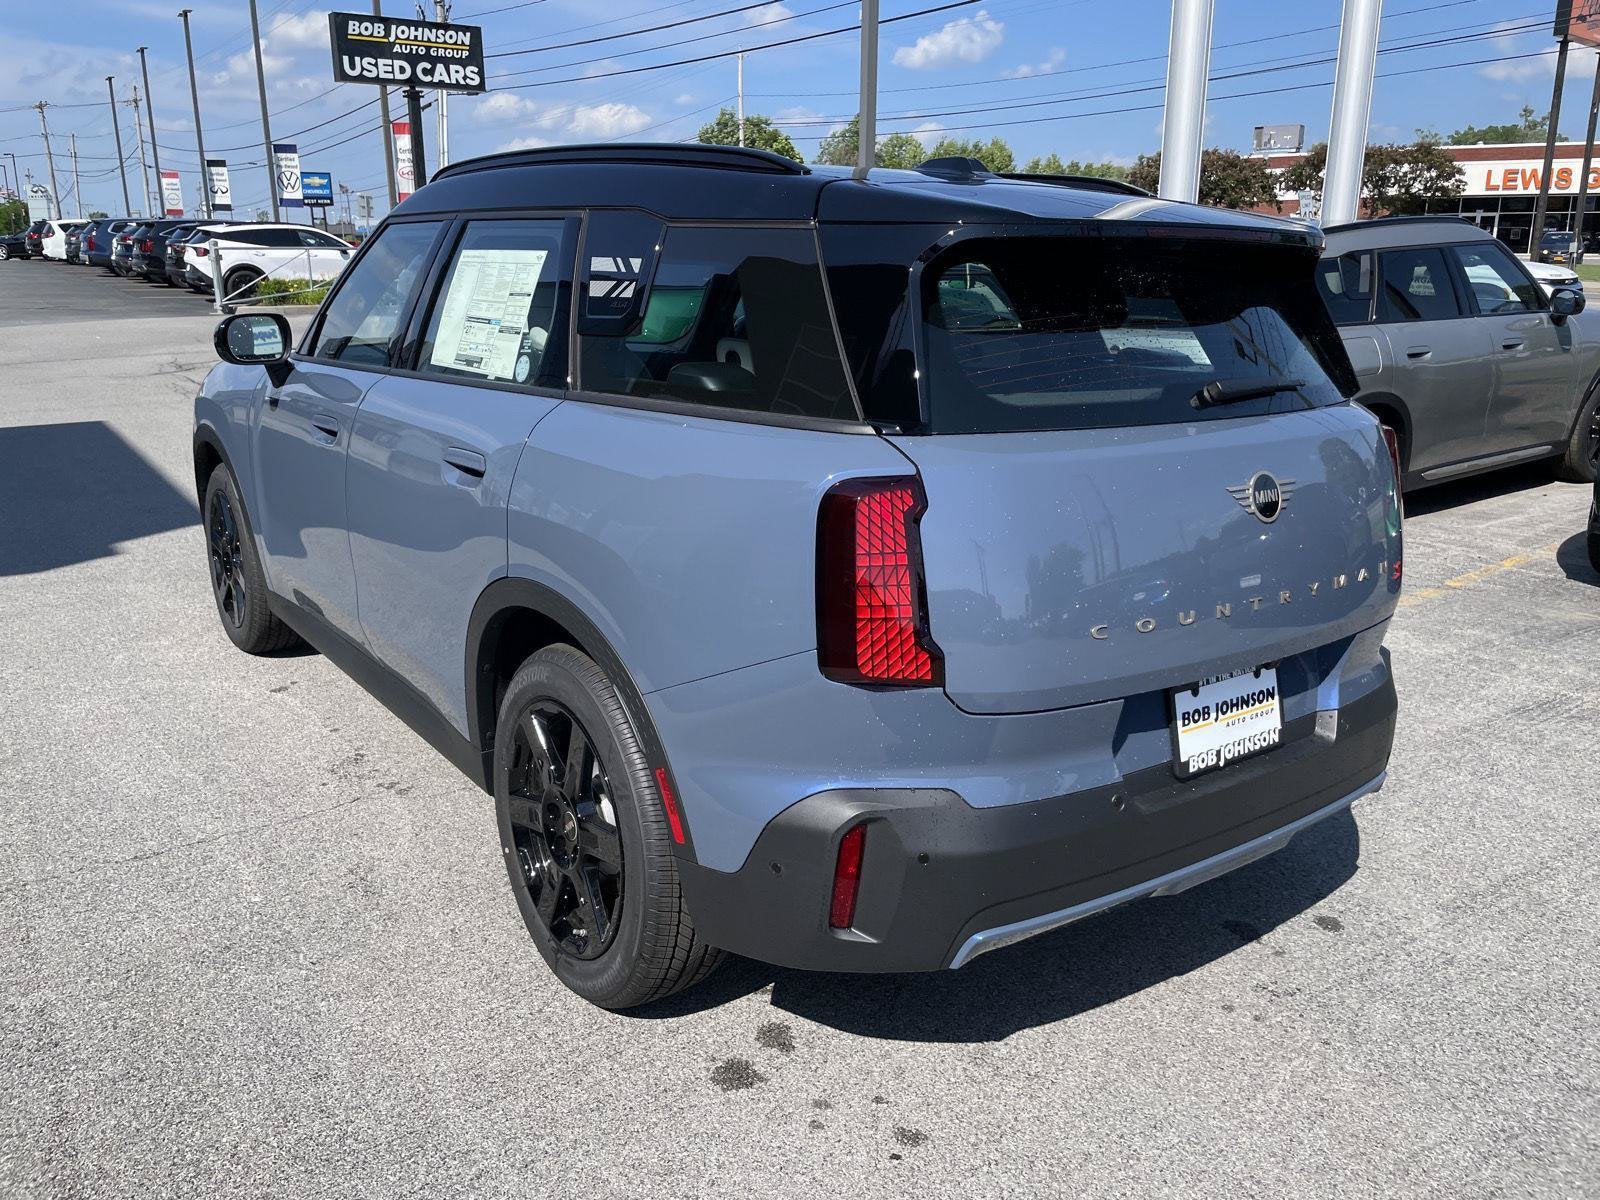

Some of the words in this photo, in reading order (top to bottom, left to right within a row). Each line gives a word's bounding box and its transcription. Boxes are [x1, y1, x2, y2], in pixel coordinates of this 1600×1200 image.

[348, 20, 385, 37] BOB
[388, 24, 471, 45] JOHNSON
[392, 44, 426, 55] AUTO
[430, 47, 469, 59] GROUP
[342, 55, 411, 80] USED
[416, 61, 480, 86] CARS
[1485, 167, 1572, 191] LEWIS
[1255, 489, 1279, 503] MINI
[1089, 561, 1388, 640] COUNTRYMAN
[1182, 705, 1211, 727] BOB
[1214, 686, 1275, 722] JOHNSON
[1226, 716, 1246, 727] AUTO
[1249, 708, 1274, 721] GROUP
[1189, 748, 1217, 773] BOB
[1219, 726, 1279, 767] JOHNSON
